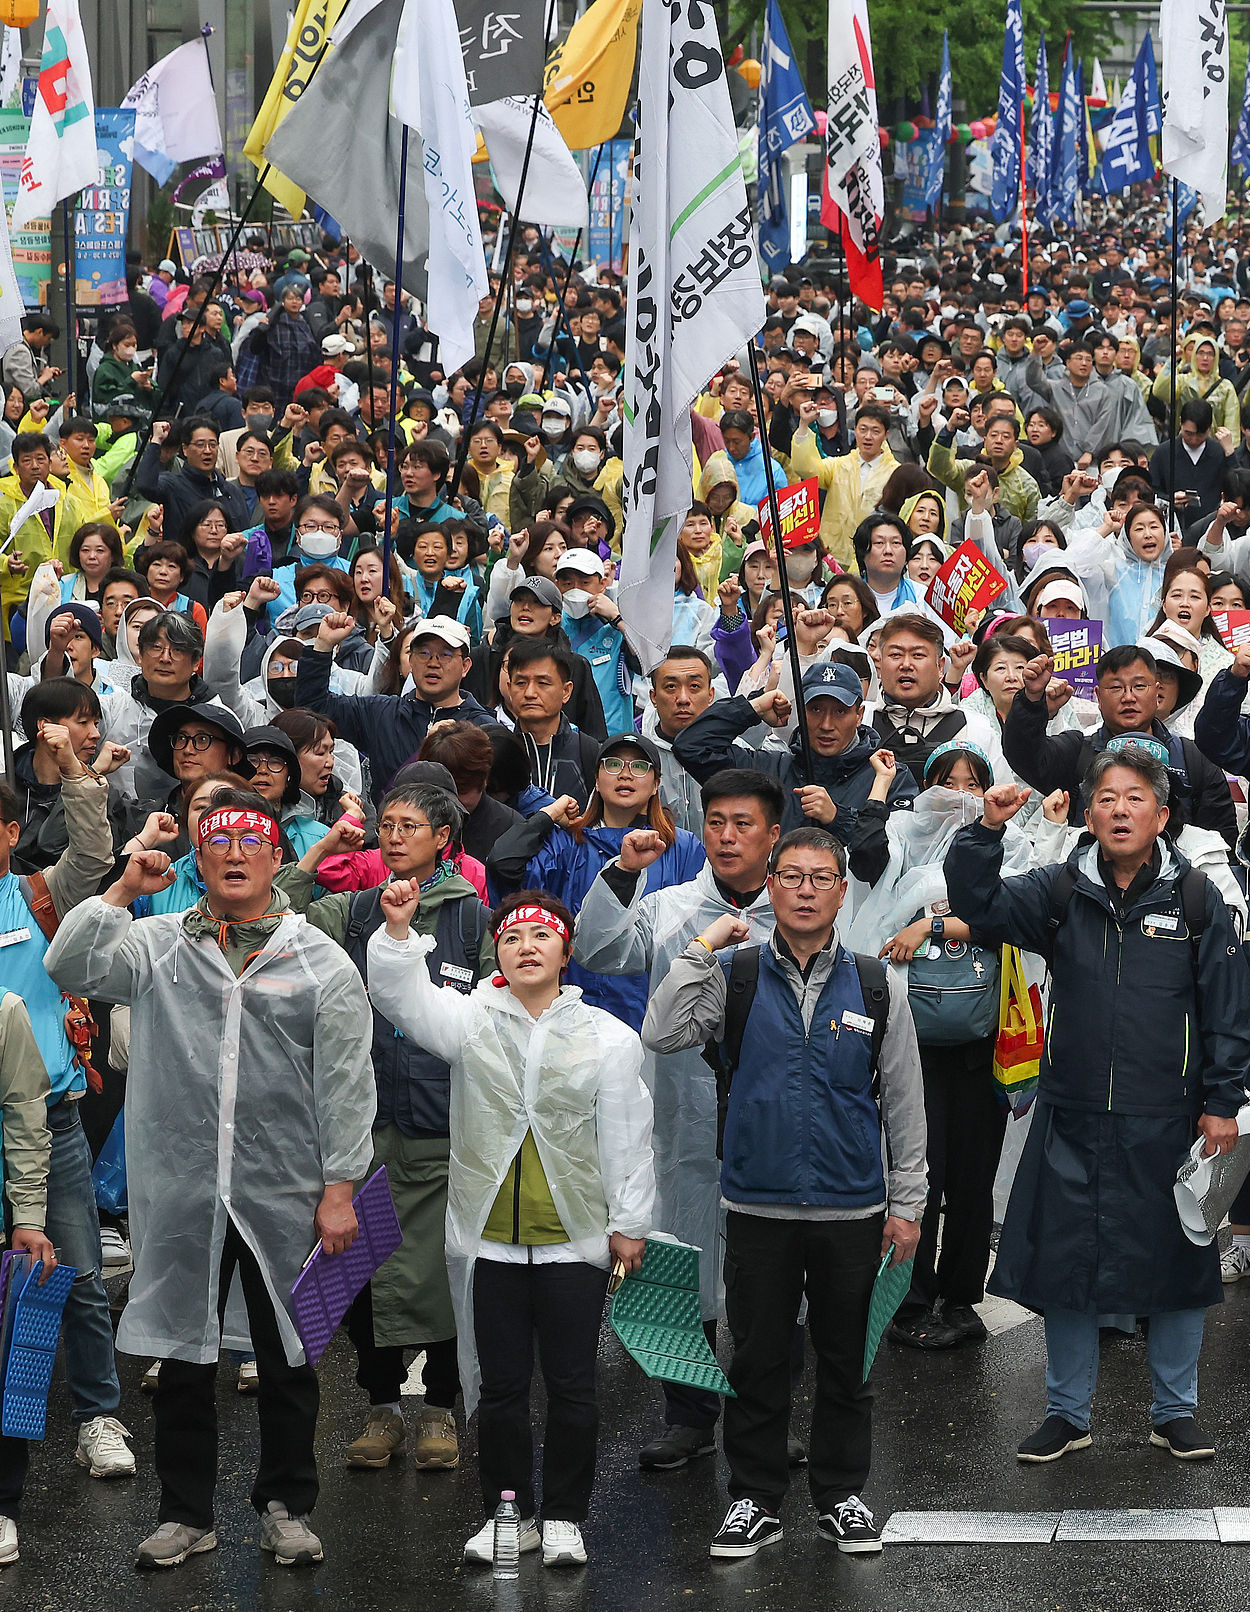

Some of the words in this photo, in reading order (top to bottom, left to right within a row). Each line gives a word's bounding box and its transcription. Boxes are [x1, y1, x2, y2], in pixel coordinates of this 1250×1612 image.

[946, 553, 973, 608] 노동자
[1050, 628, 1087, 651] 본법
[200, 813, 221, 838] 단결
[244, 812, 272, 835] 투쟁
